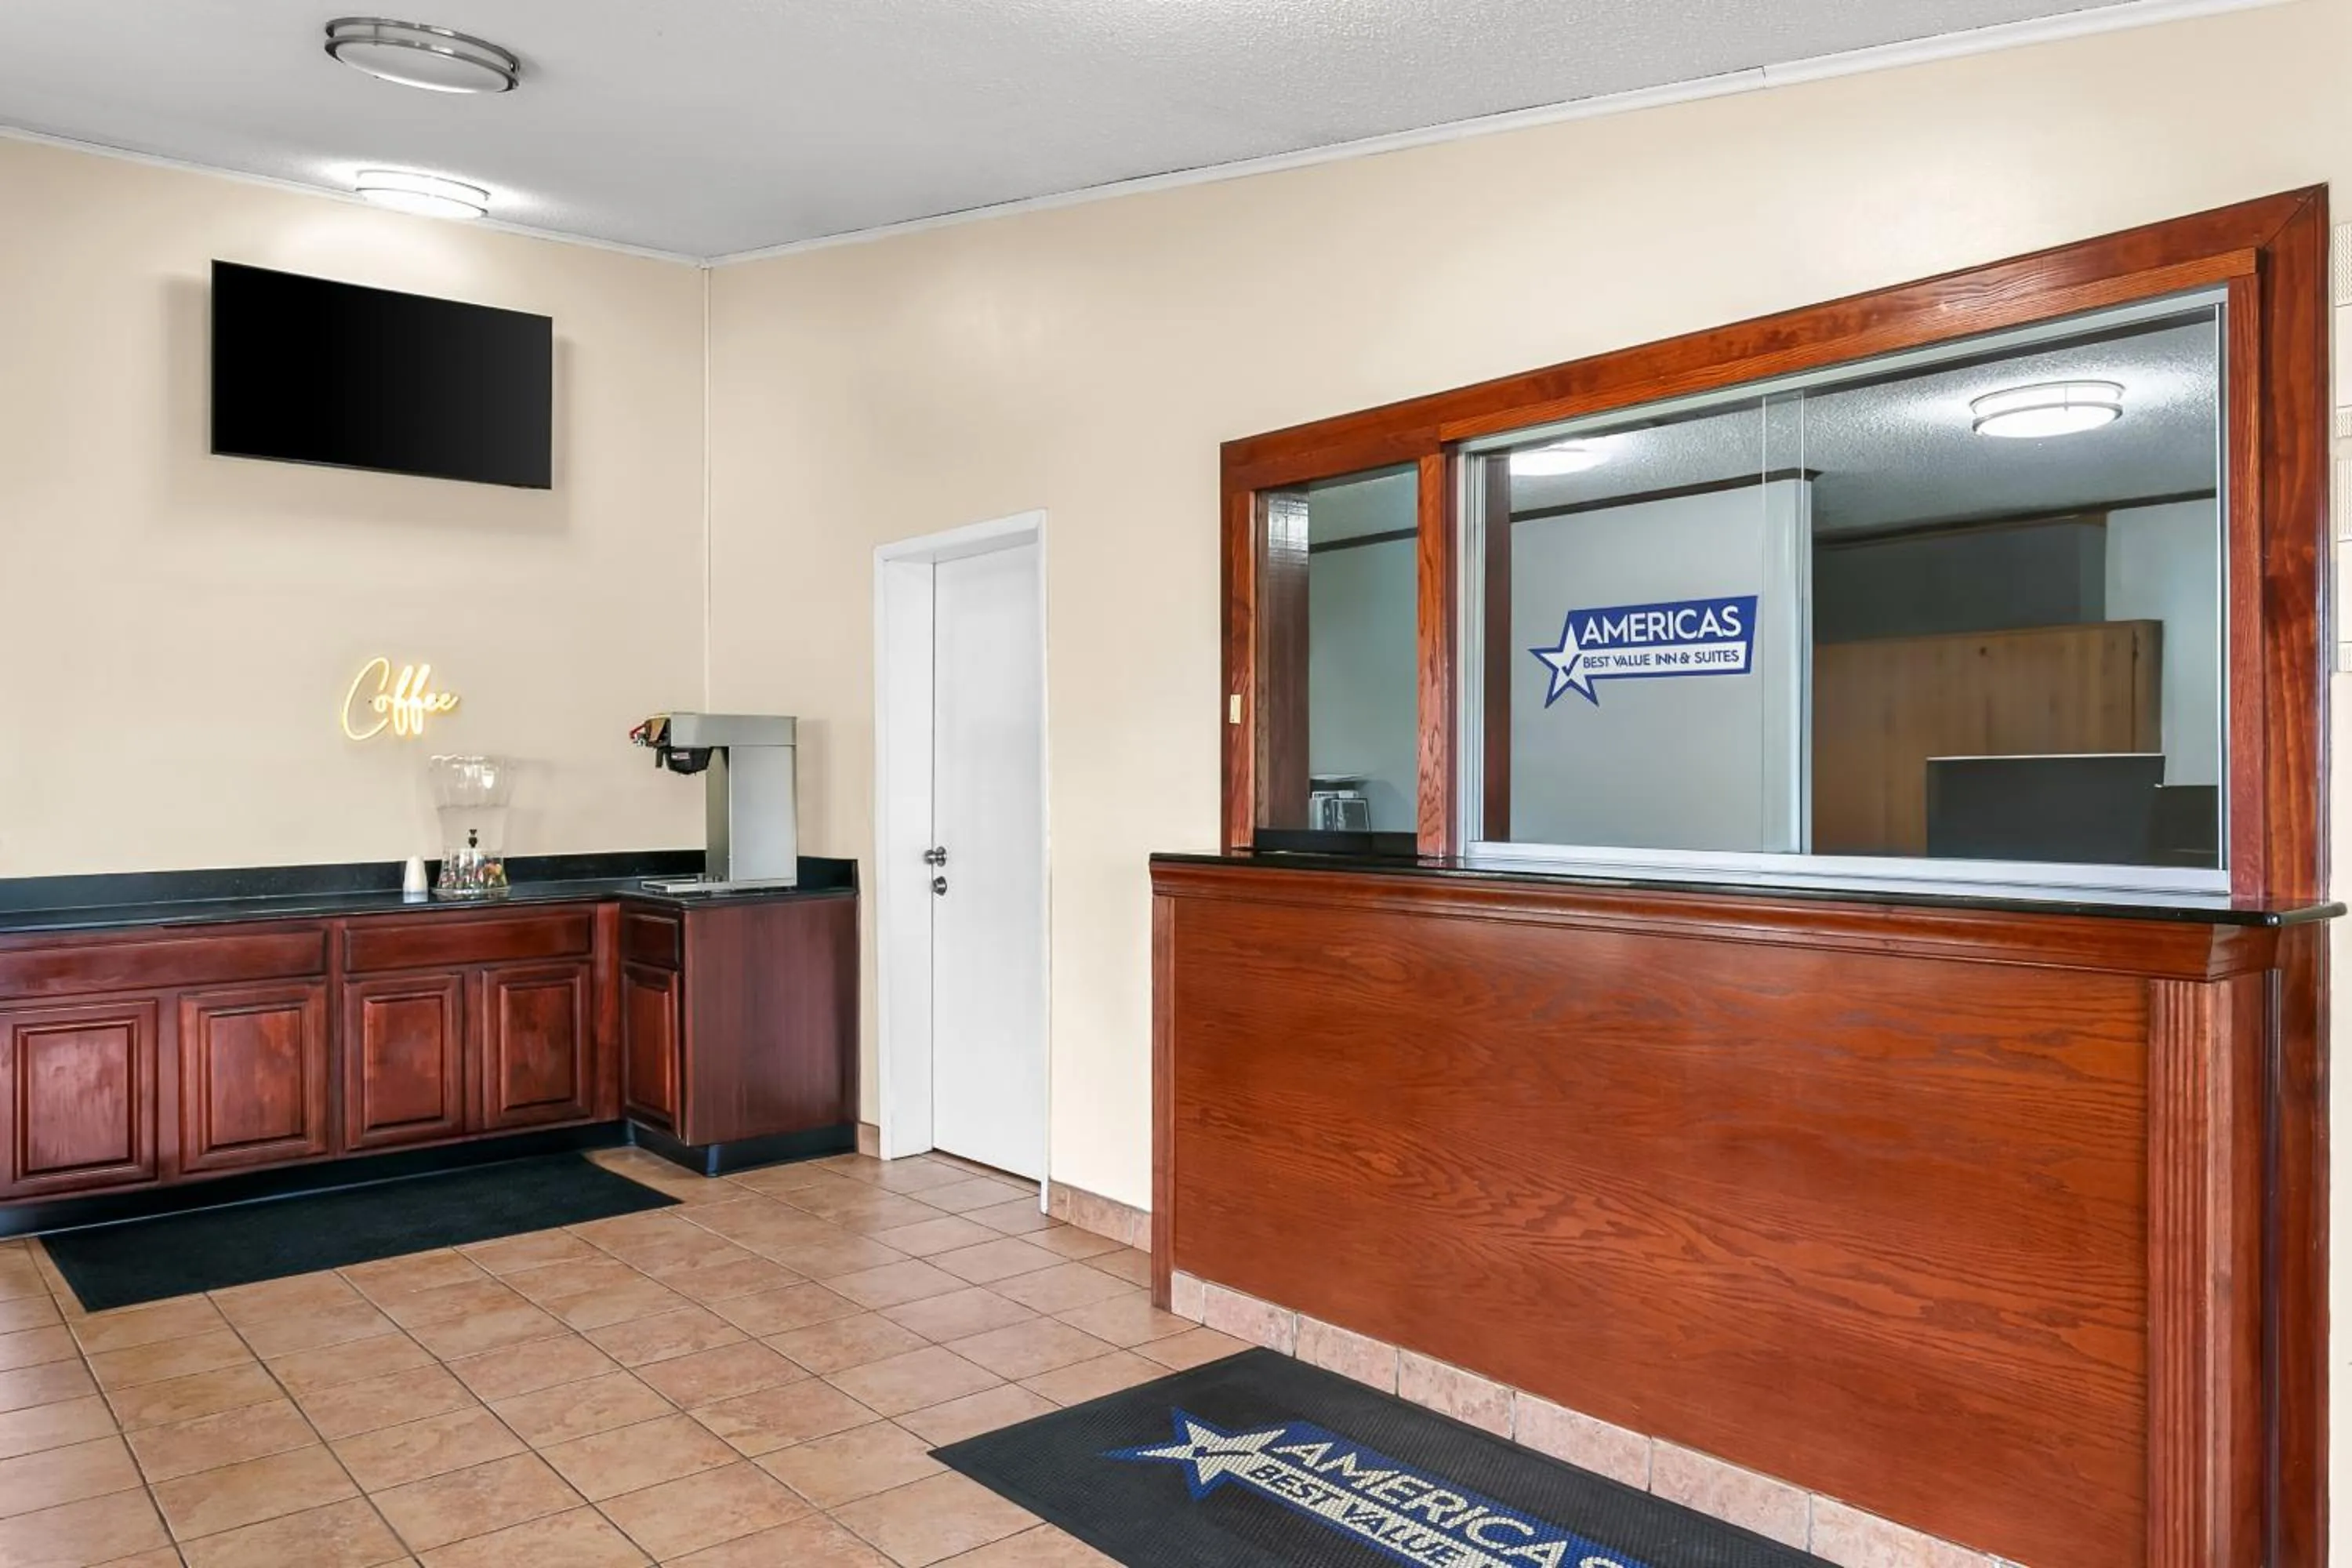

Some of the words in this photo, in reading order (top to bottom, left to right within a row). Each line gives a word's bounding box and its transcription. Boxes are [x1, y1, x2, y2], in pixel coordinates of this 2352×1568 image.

[1580, 605, 1742, 645] AMERICAS
[1583, 656, 1610, 669] BEST
[1613, 655, 1651, 667] VALUE
[1655, 654, 1678, 666] INN
[1680, 652, 1690, 664] &
[1694, 650, 1740, 663] SUITES
[343, 656, 460, 741] Coffee
[1247, 1464, 1344, 1506] BEST
[1342, 1503, 1467, 1568] VALUE
[1271, 1441, 1624, 1568] AMERICA
